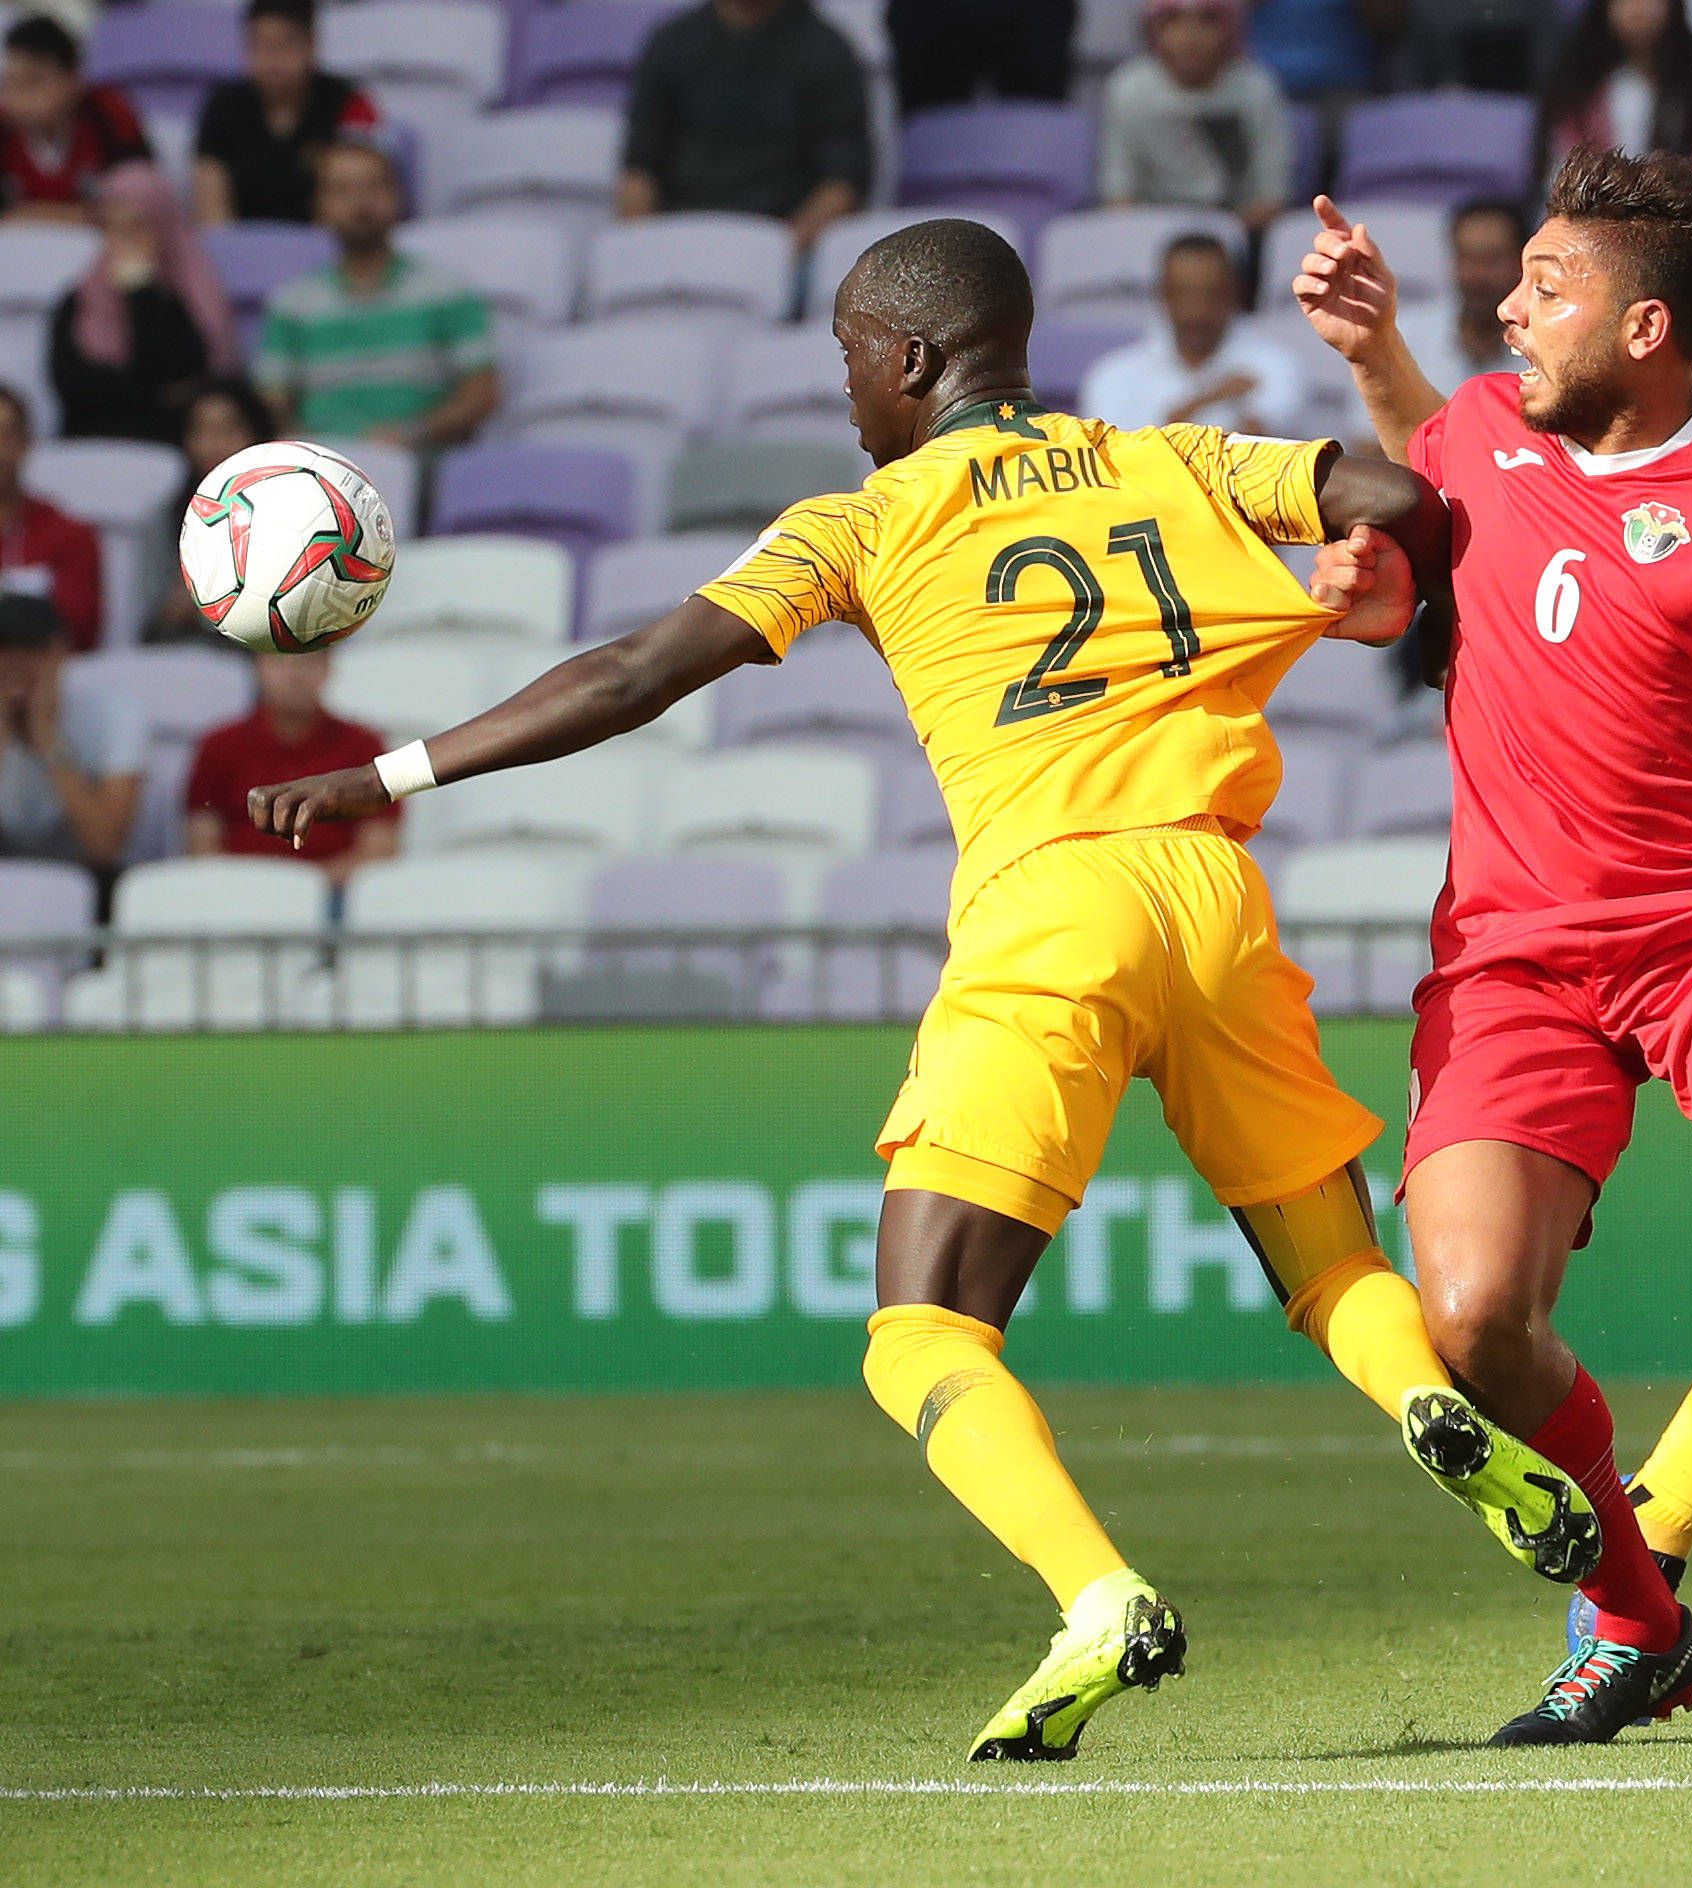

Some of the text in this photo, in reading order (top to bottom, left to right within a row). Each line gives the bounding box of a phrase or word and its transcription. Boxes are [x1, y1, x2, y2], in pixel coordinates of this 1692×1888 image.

[969, 446, 1120, 508] MABIL
[985, 517, 1200, 727] 21
[1534, 548, 1587, 643] 6
[72, 1183, 514, 1327] ASIA
